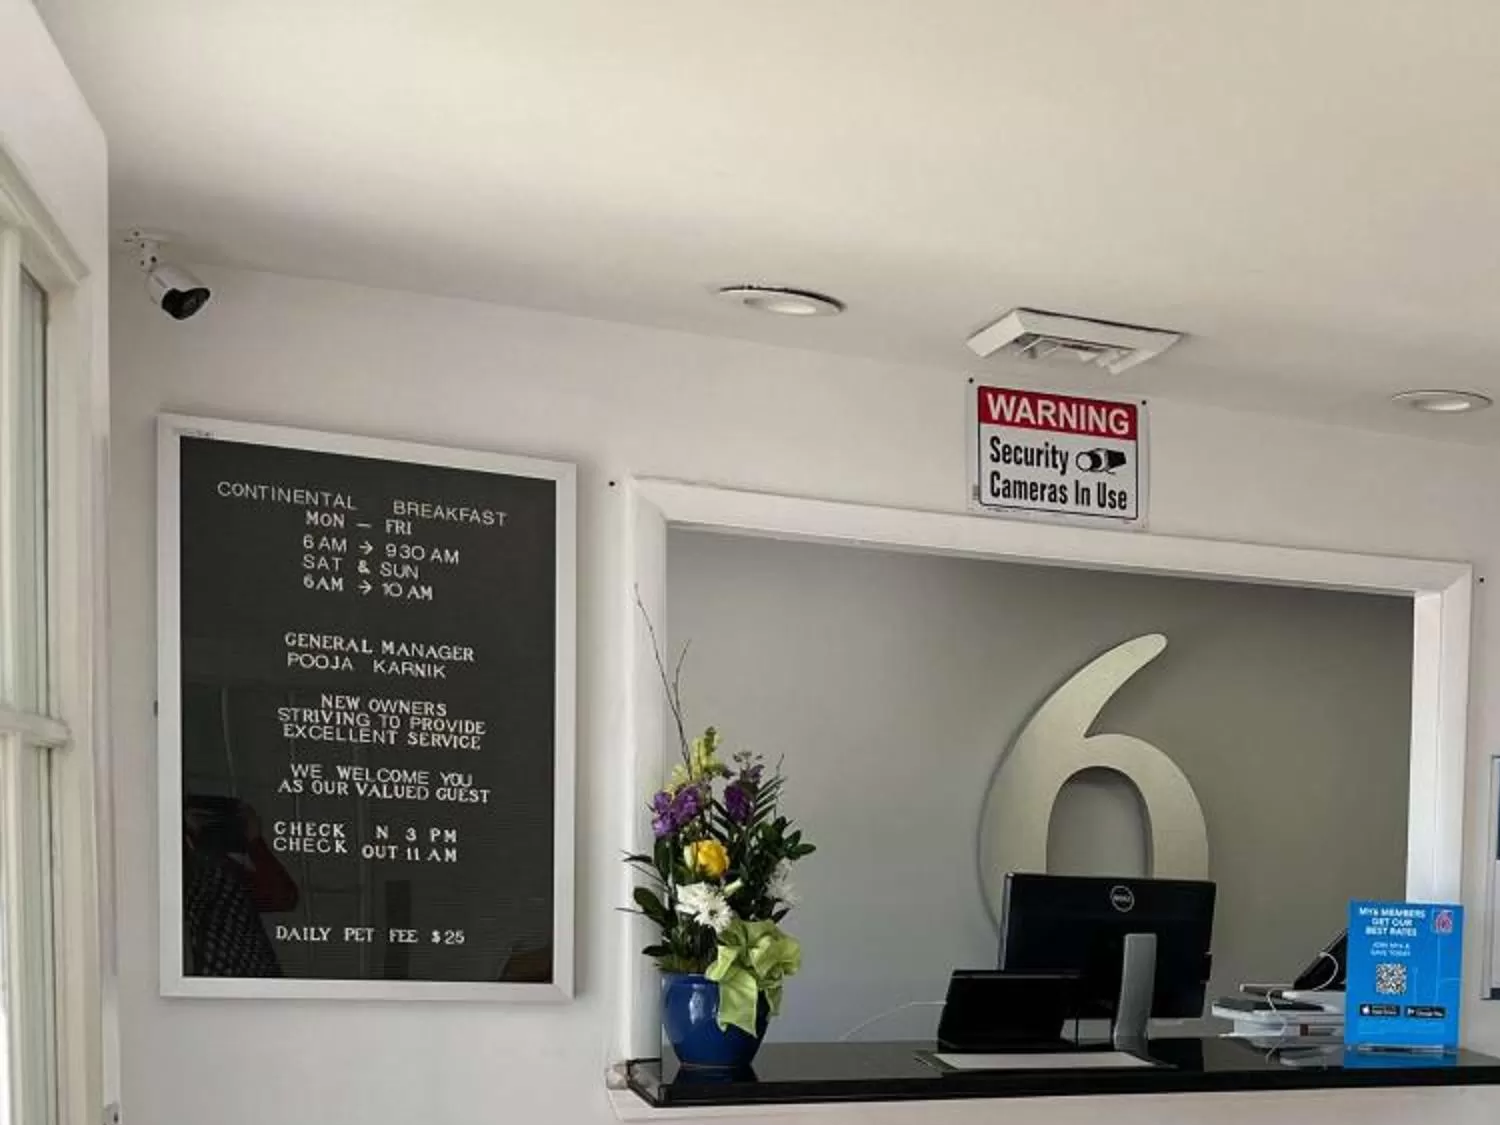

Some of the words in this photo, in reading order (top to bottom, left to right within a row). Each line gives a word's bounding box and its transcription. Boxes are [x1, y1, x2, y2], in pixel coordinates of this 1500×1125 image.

[987, 392, 1129, 434] WARNING
[990, 436, 1069, 475] Security
[990, 471, 1068, 504] Cameras
[1075, 480, 1091, 506] In
[1097, 482, 1127, 509] Use
[217, 481, 357, 510] CONTINENTAL
[393, 500, 508, 527] BREAKFAST
[306, 510, 345, 529] MON
[385, 519, 412, 536] FRI
[303, 533, 315, 549] 6
[318, 536, 347, 553] AM
[430, 547, 460, 565] AM
[303, 553, 344, 571] SAT
[357, 559, 371, 575] &
[379, 561, 419, 580] SUN
[381, 581, 403, 598] 10
[406, 585, 433, 601] AM
[284, 632, 373, 654] GENERAL
[381, 639, 474, 662] MANAGER
[287, 652, 353, 671] POOJA
[373, 659, 446, 679] KARNIK
[321, 693, 361, 711] NEW
[367, 698, 447, 717] OWNERS
[277, 707, 371, 728] STRIVING
[379, 713, 401, 729] TO
[409, 715, 486, 735] PROVIDE
[283, 723, 399, 745] EXCELLENT
[407, 731, 481, 751] SERVICE
[290, 763, 323, 779] WE
[335, 765, 430, 786] WELCOME
[439, 771, 473, 789] YOU
[977, 632, 1209, 925] 6
[278, 779, 304, 794] AS
[311, 779, 349, 796] OUR
[355, 781, 430, 801] VALUED
[435, 787, 491, 804] GUEST
[273, 820, 346, 839] CHECK
[405, 827, 417, 843] 3
[429, 827, 457, 844] PM
[273, 836, 348, 854] CHECK
[361, 844, 398, 860] OUT
[406, 847, 420, 861] 11
[427, 847, 457, 863] AM
[275, 925, 332, 942] DAILY
[344, 927, 374, 943] PET
[389, 928, 418, 943] FEE
[431, 929, 465, 945] $25
